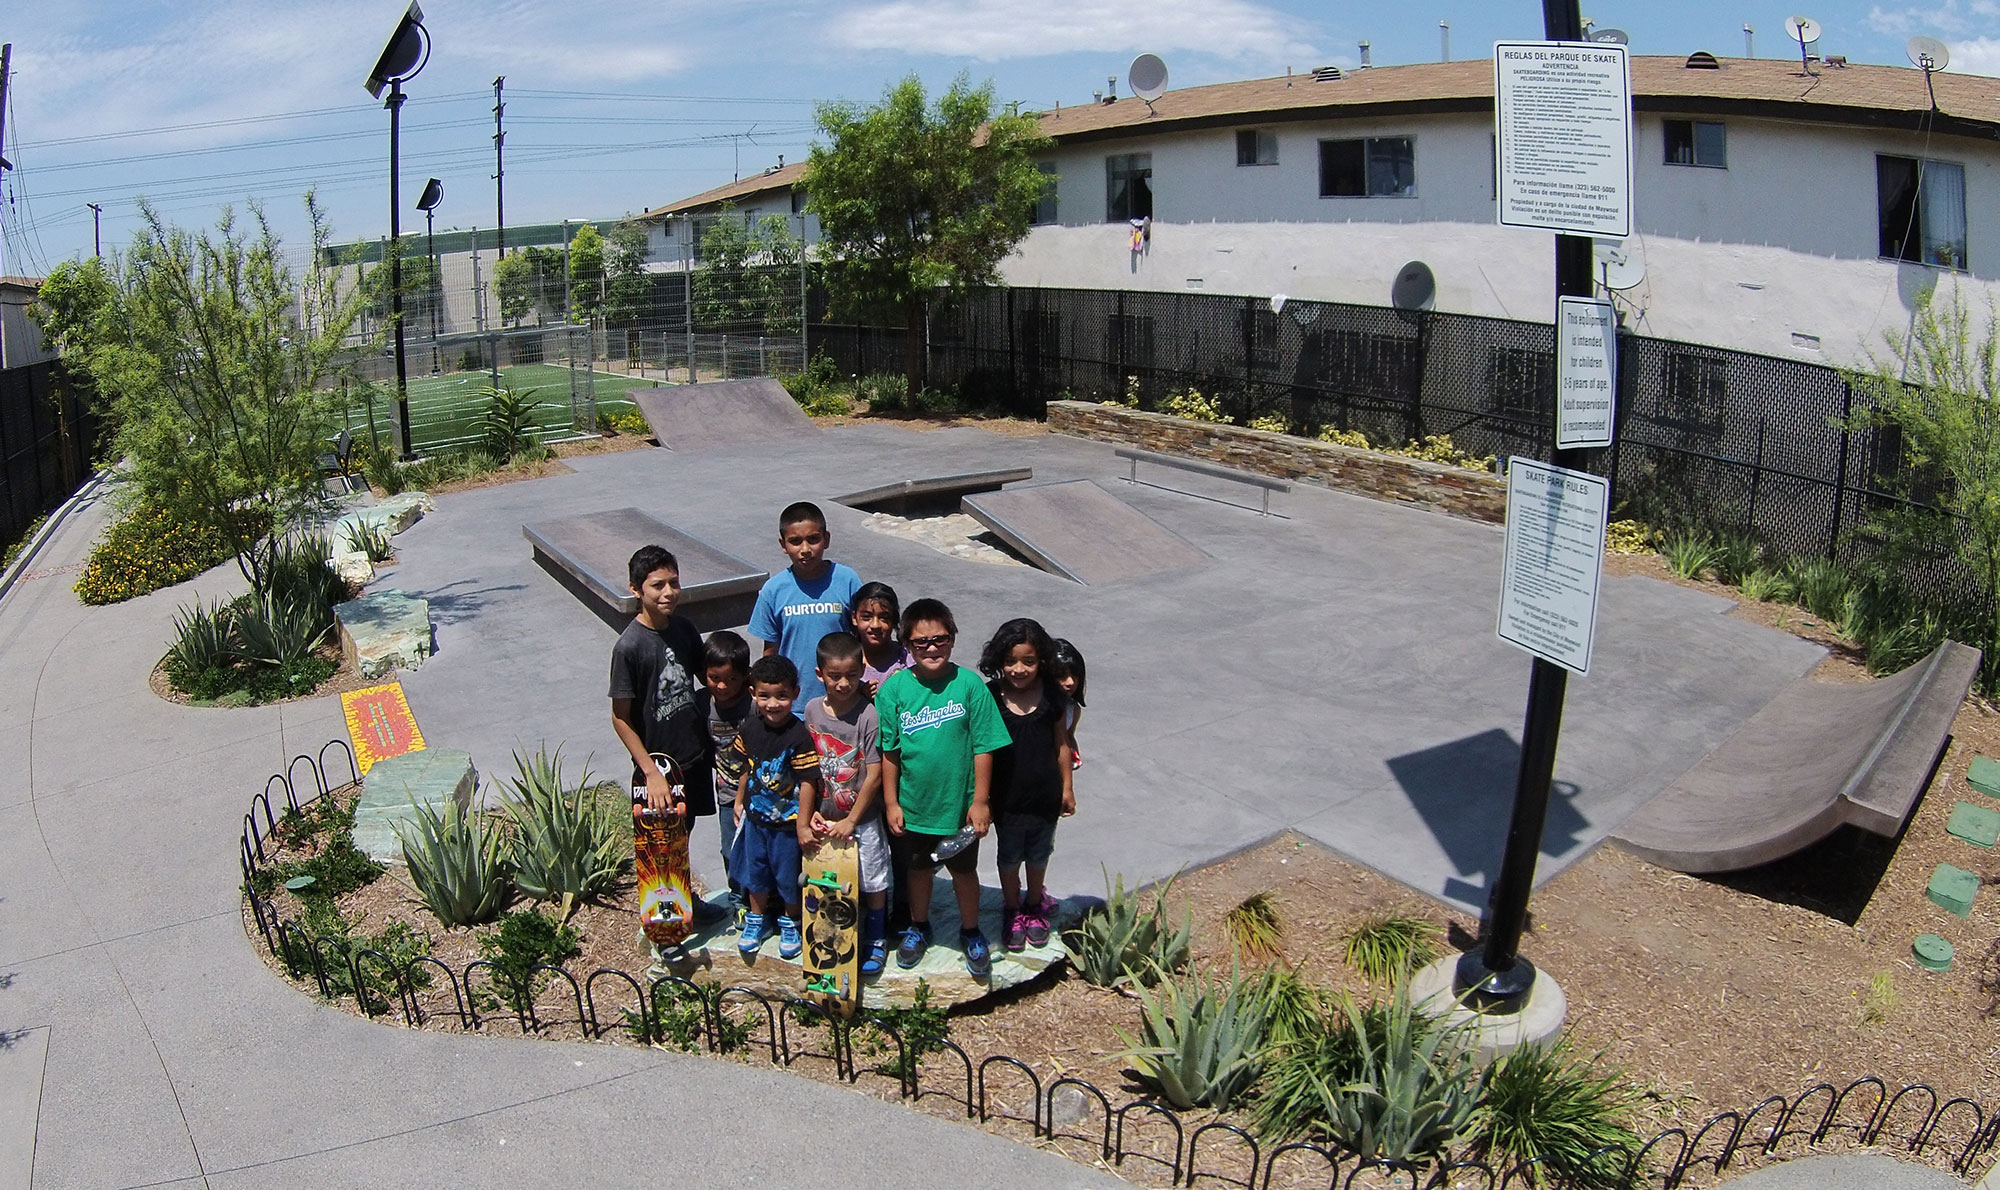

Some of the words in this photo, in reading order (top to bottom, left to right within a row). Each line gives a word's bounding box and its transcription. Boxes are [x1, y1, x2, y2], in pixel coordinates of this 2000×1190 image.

[1504, 52, 1532, 60] REGLAS
[1535, 52, 1548, 60] DEL
[1550, 53, 1579, 61] PARQUE
[1582, 54, 1592, 62] DE
[1594, 54, 1617, 63] SKATE
[1595, 205, 1619, 213] Maywood
[1567, 312, 1577, 325] This
[1579, 315, 1608, 328] equipment
[1572, 334, 1576, 346] is
[1577, 334, 1602, 347] intended
[1570, 356, 1578, 367] for
[1579, 356, 1602, 368] children
[1564, 377, 1572, 389] 2-5
[1572, 379, 1588, 391] years
[1589, 378, 1595, 389] of
[1597, 380, 1609, 391] age.
[1563, 399, 1575, 410] Adult
[1576, 399, 1609, 412] supervision
[1525, 470, 1545, 484] SKATE
[1546, 476, 1565, 488] PARK
[1566, 481, 1589, 495] RULES
[784, 602, 833, 616] BURTON
[900, 711, 918, 728] Los
[917, 700, 966, 728] Angeles
